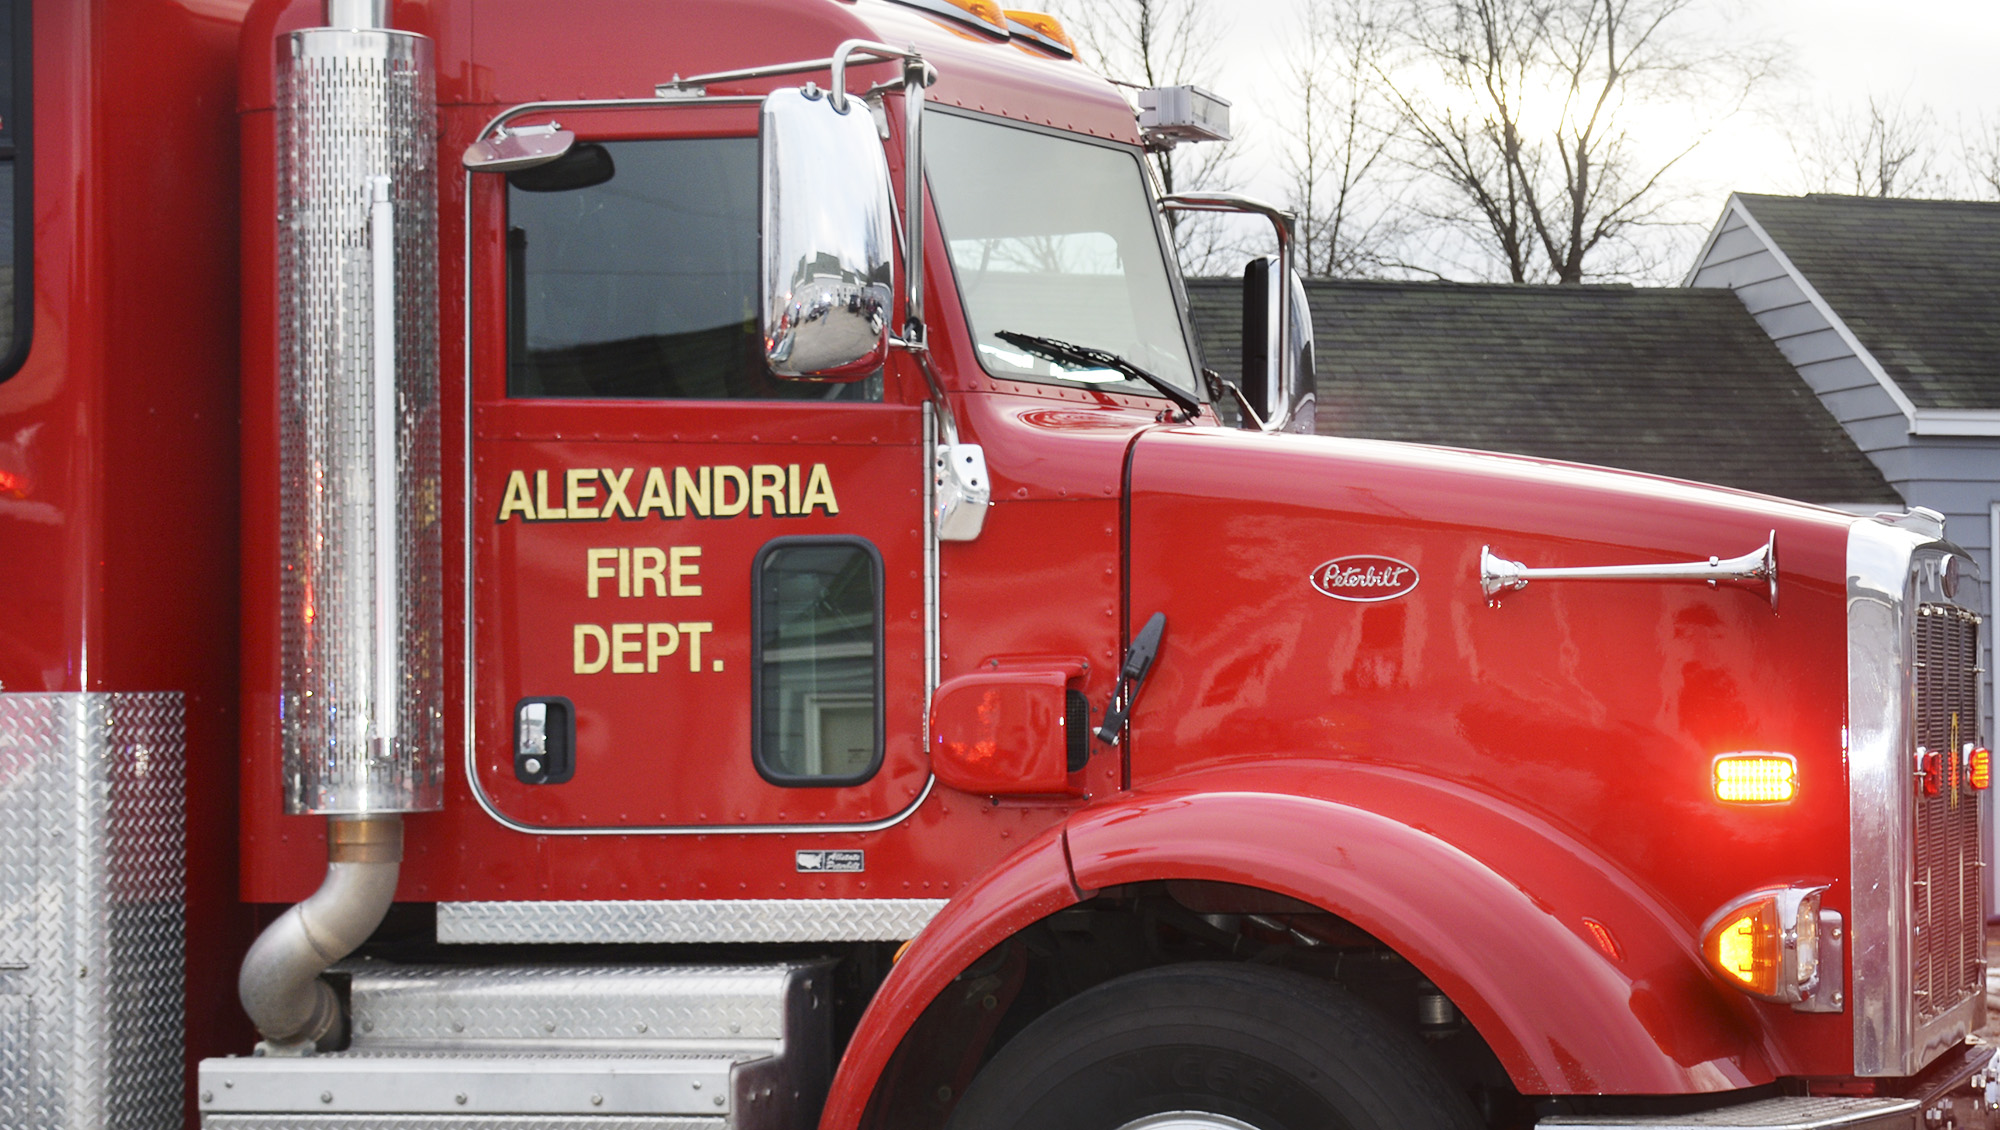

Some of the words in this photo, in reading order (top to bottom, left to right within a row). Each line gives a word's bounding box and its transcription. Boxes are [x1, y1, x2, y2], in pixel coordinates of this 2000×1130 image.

[497, 463, 840, 522] ALEXANDRIA
[587, 546, 703, 598] FIRE
[1323, 563, 1409, 589] Peterbilt
[573, 622, 725, 675] DEPT.
